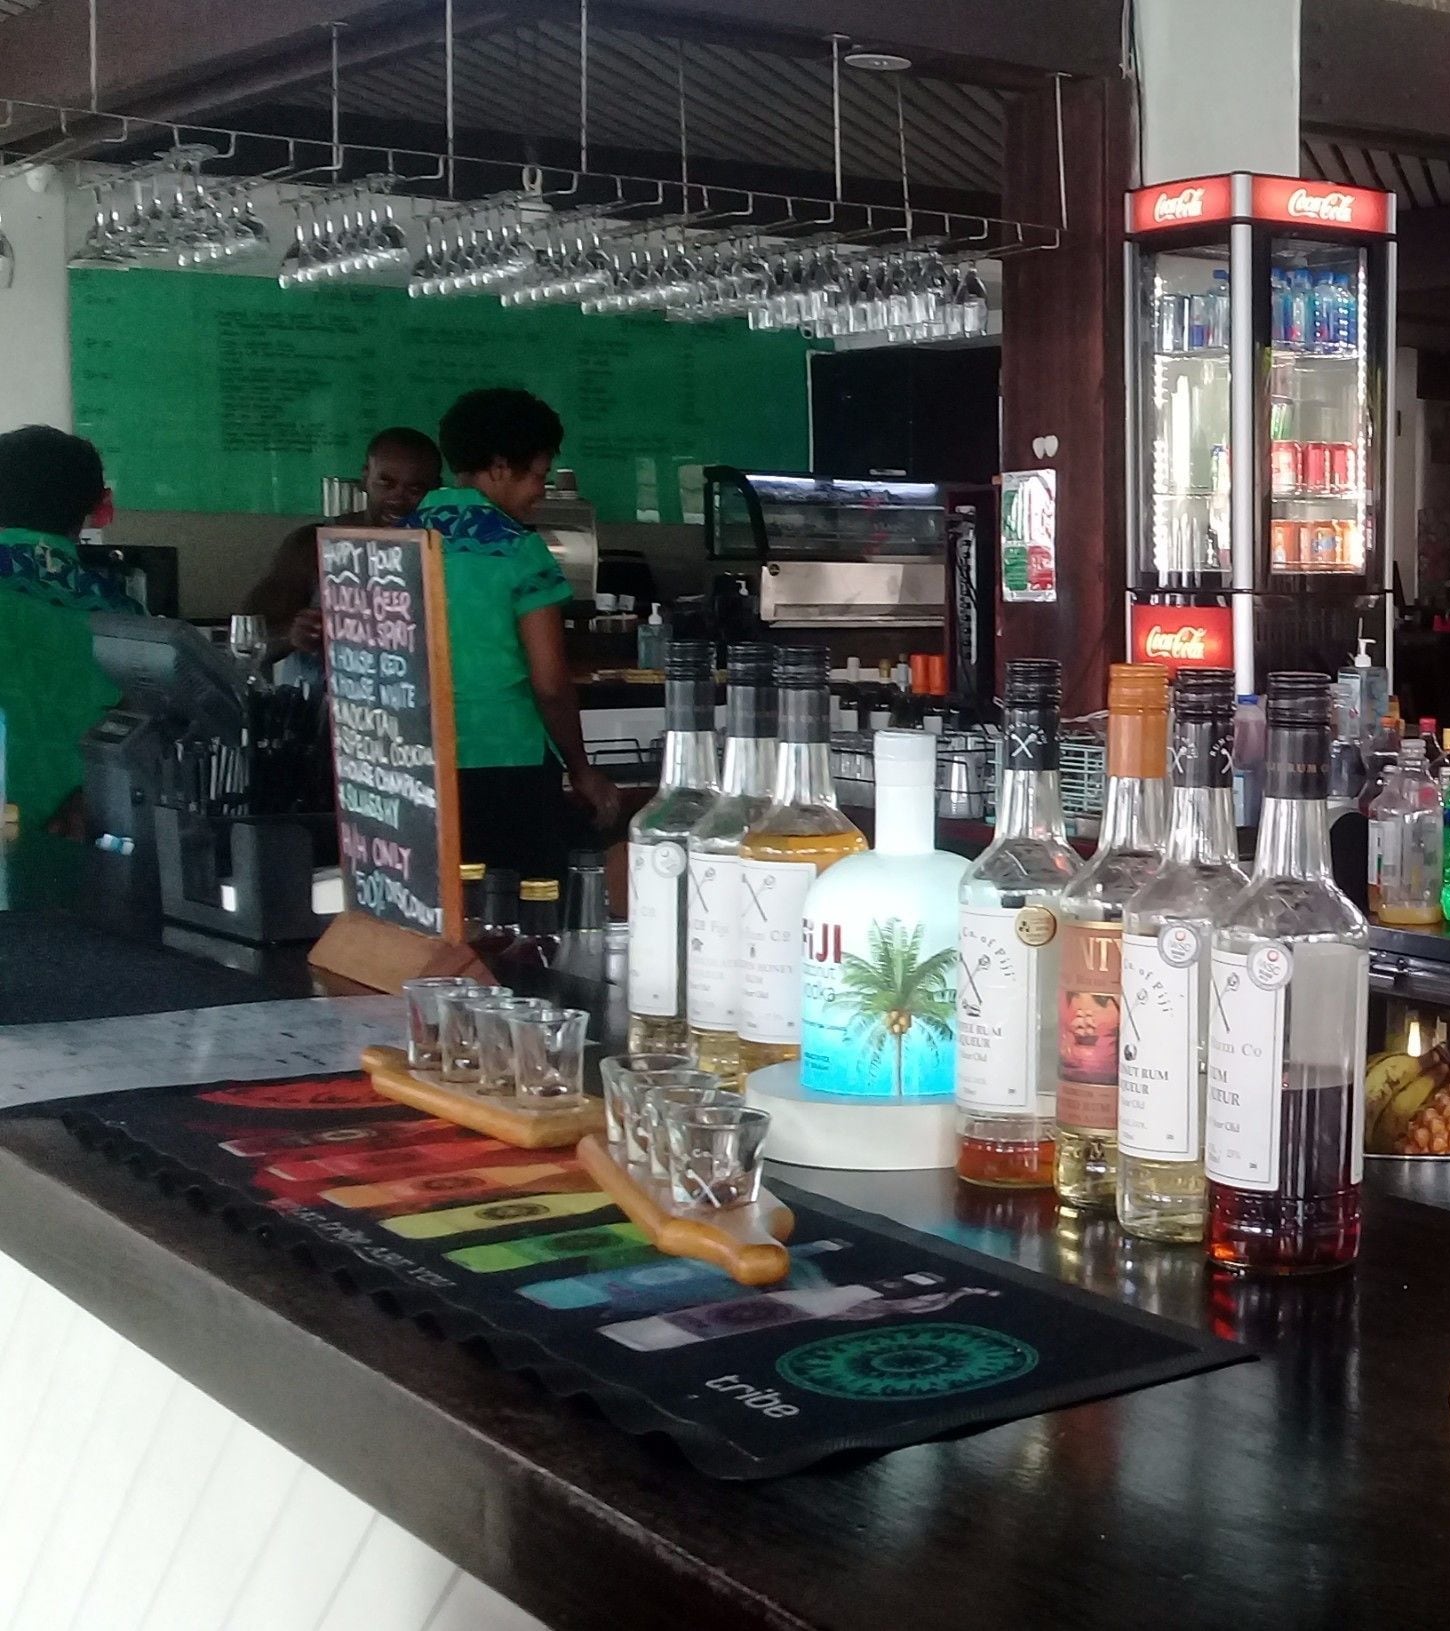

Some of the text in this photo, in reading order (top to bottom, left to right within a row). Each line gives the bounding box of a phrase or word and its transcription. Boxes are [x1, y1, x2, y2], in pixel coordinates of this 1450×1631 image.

[366, 541, 403, 577] HOUR
[373, 584, 411, 621] BEER
[379, 652, 407, 677] RED
[372, 838, 411, 881] ONLY
[704, 1374, 800, 1418] tribe
